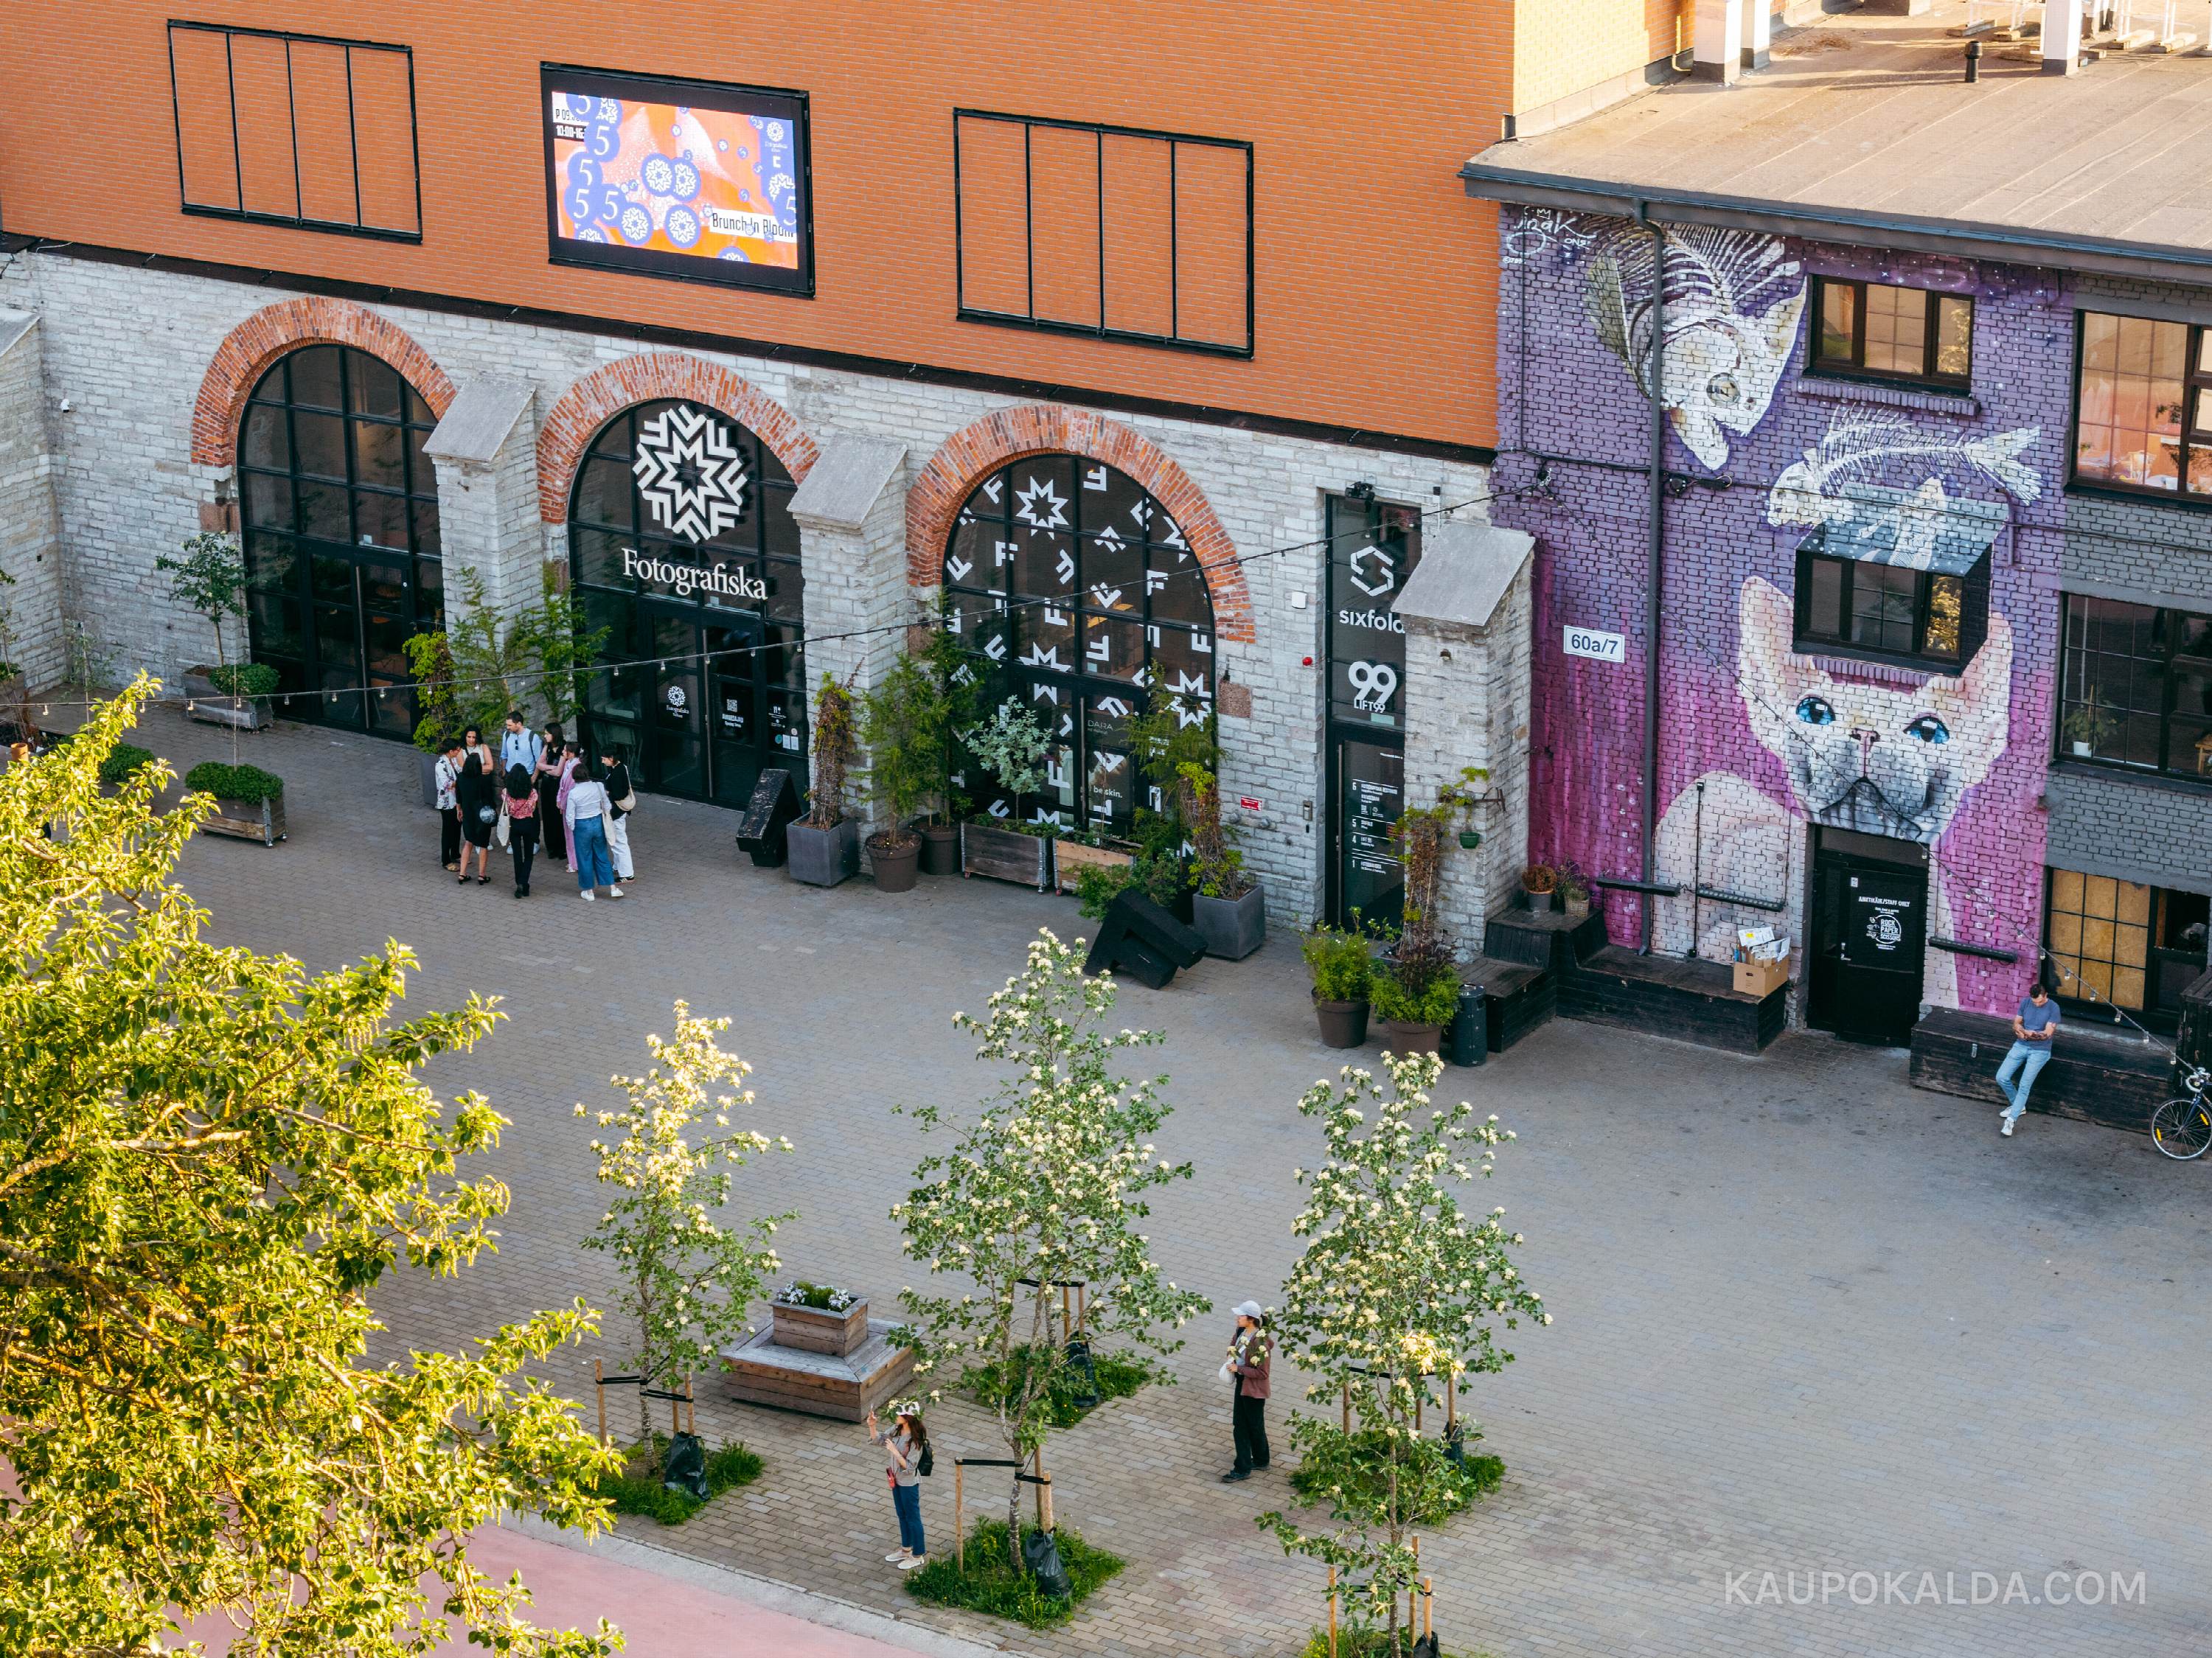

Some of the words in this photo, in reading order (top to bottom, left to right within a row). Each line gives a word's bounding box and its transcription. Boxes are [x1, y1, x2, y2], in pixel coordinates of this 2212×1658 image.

[712, 212, 746, 231] Brunch
[621, 548, 768, 599] Fotografiska
[1571, 634, 1618, 655] 60a/7
[1348, 661, 1397, 705] 99
[1354, 700, 1386, 714] LIFT99
[1093, 785, 1103, 794] be
[1104, 788, 1123, 798] skin.
[1352, 782, 1357, 791] 6
[1352, 818, 1357, 827] 5
[1352, 835, 1357, 843] 4
[1880, 919, 1896, 927] ROCK
[1880, 926, 1899, 934] PAPER
